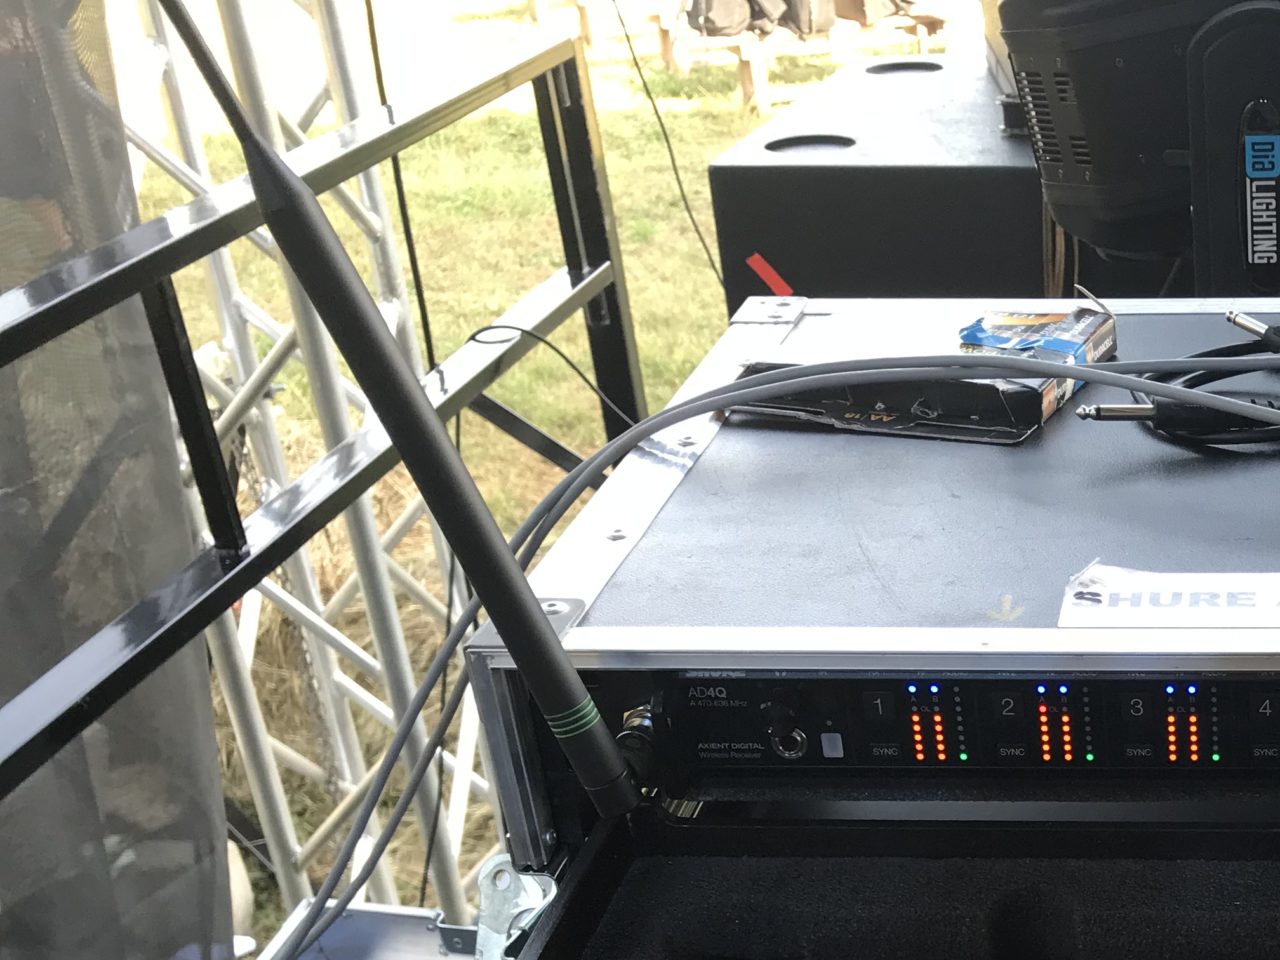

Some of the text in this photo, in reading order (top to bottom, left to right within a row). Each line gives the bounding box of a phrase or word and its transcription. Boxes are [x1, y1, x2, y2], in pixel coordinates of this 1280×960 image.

[1252, 180, 1278, 264] LIGHTING
[1072, 590, 1257, 609] SHURE
[688, 687, 727, 698] AD4Q
[873, 697, 883, 716] 1
[1001, 698, 1015, 716] 2
[1130, 698, 1144, 716] 3
[1259, 699, 1273, 717] 4
[872, 747, 898, 756] SYNC
[999, 748, 1025, 756] SYNC
[1126, 748, 1152, 756] SYNC
[1253, 748, 1279, 757] SYNC
